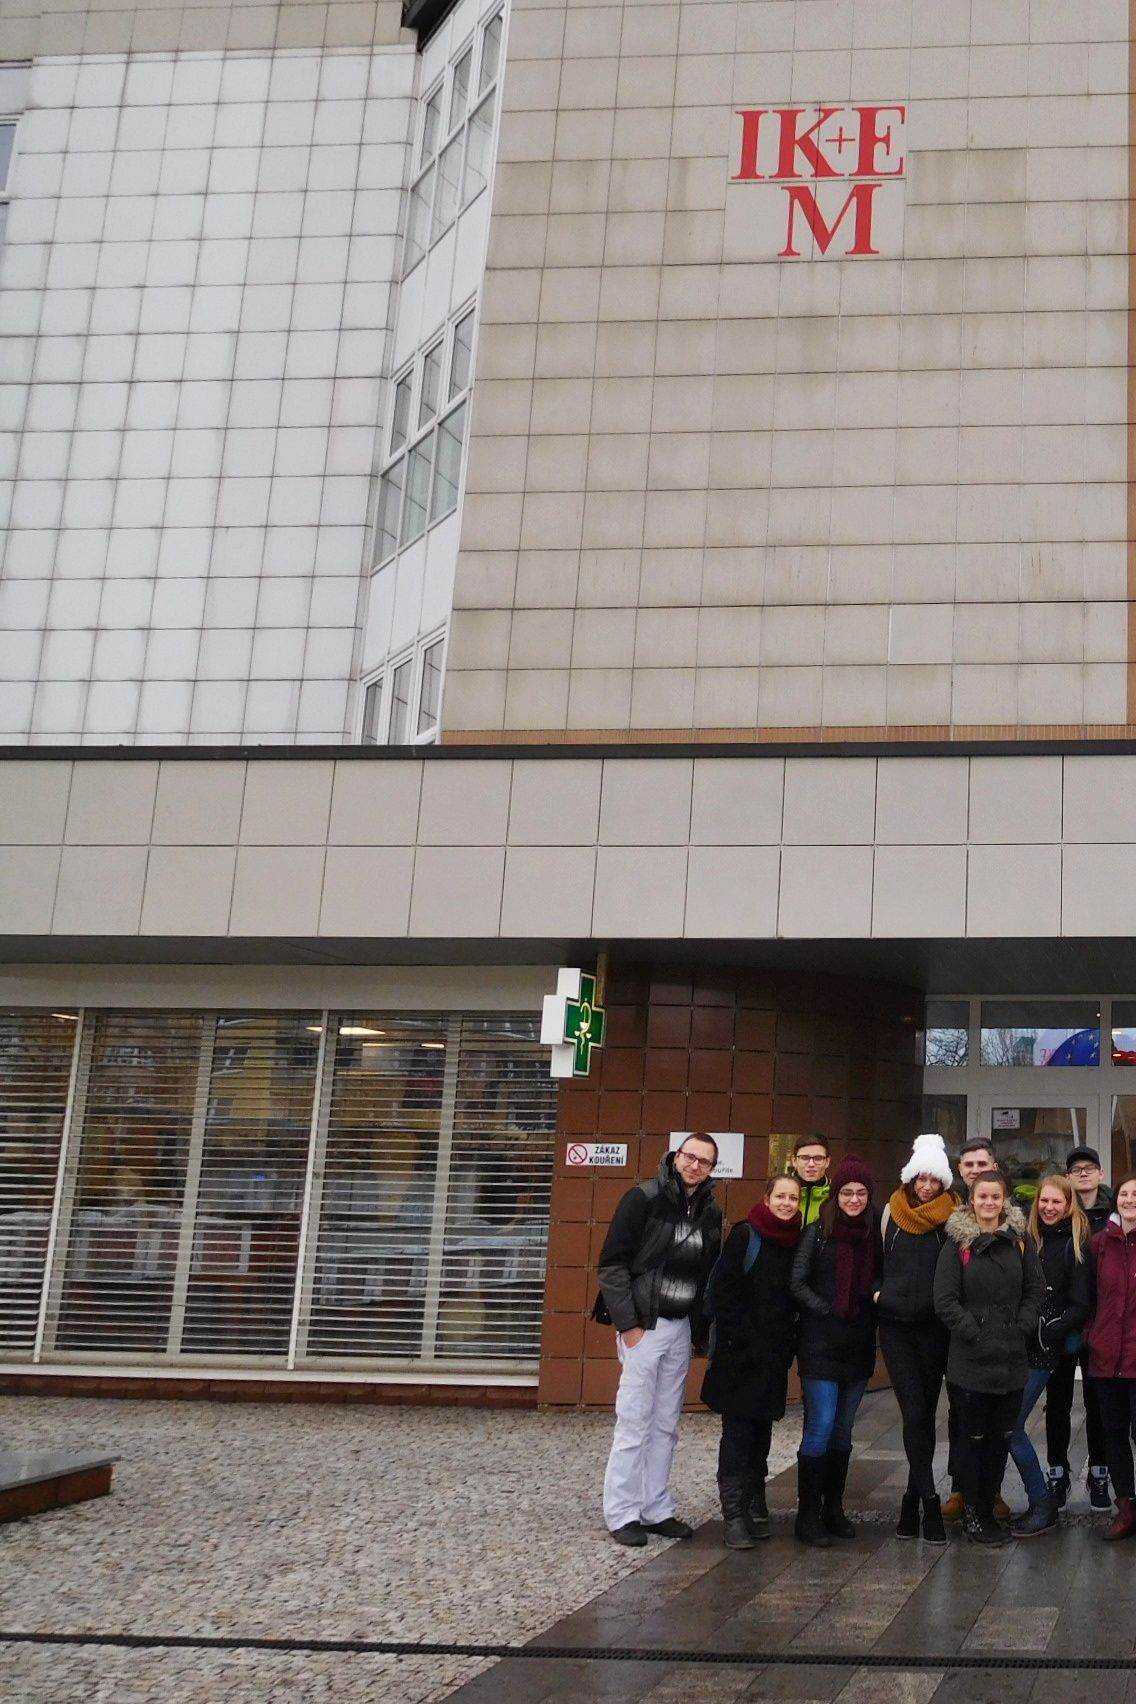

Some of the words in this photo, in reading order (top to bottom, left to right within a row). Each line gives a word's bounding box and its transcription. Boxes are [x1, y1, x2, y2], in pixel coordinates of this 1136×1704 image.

[778, 183, 882, 257] M
[595, 1145, 620, 1155] ZÁKAZ
[589, 1155, 624, 1165] KOUŘENÍ
